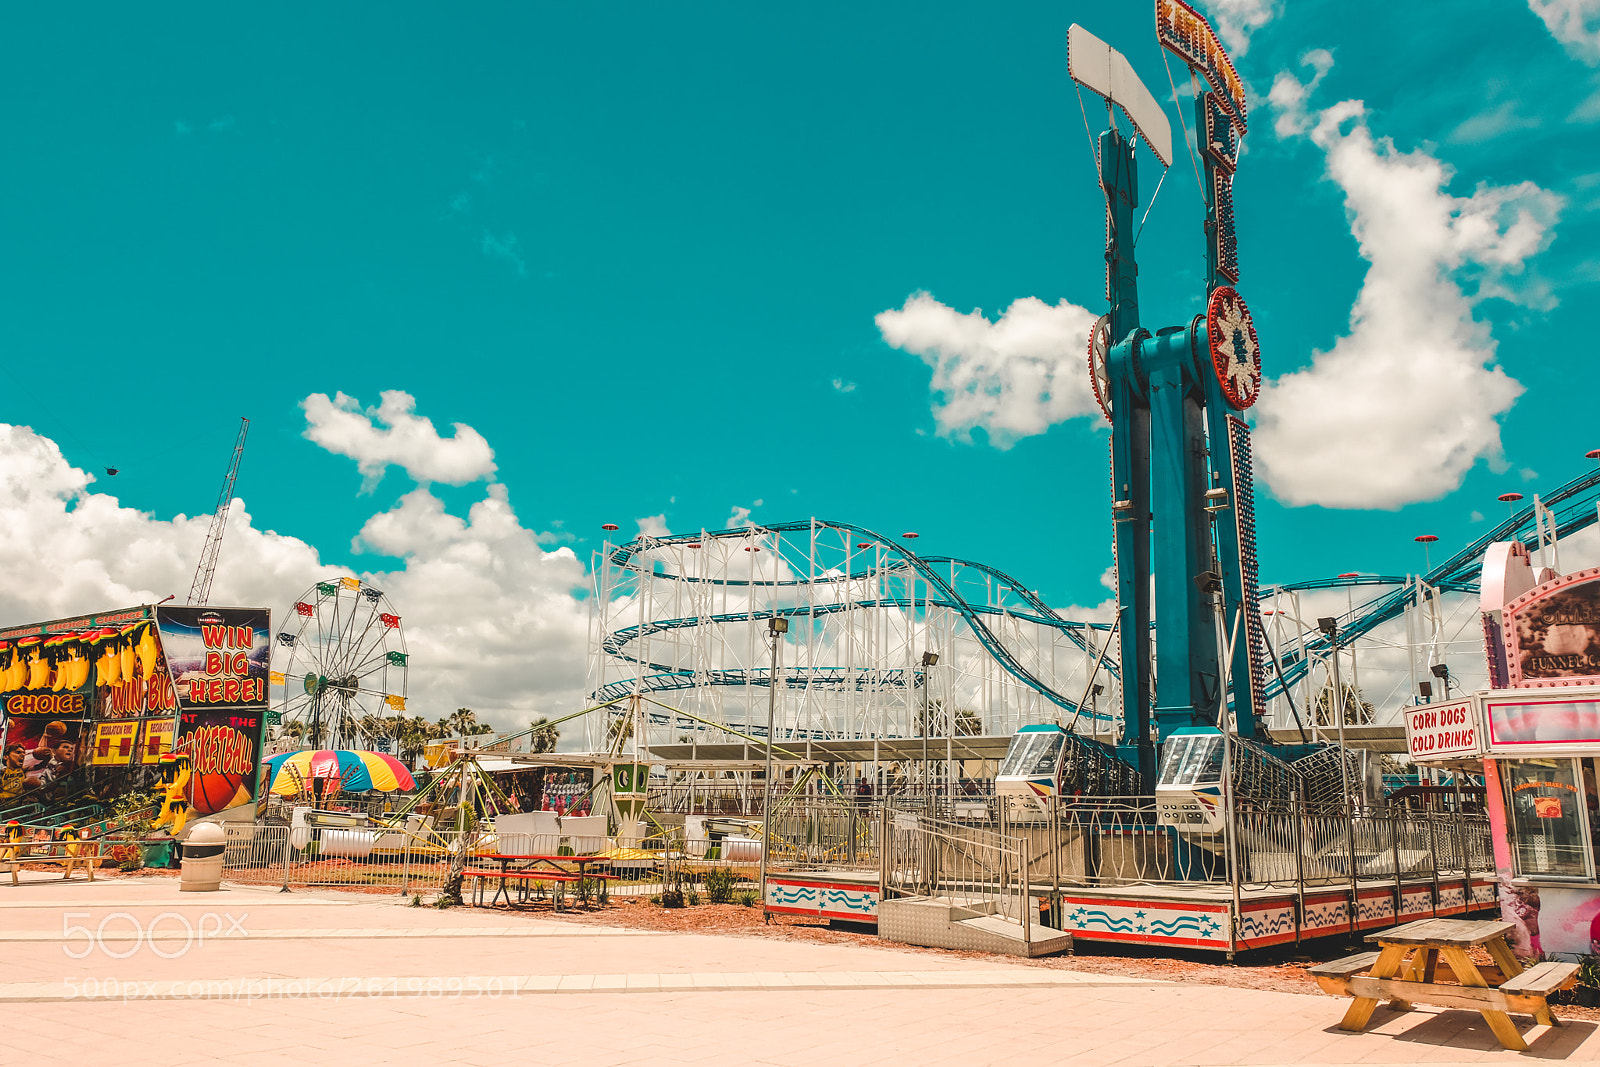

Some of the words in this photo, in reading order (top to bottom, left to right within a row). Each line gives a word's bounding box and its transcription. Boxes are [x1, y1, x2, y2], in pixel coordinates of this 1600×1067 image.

[1, 627, 42, 639] CHOICE
[46, 619, 91, 632] CHOICE
[95, 611, 144, 625] CHOICE
[202, 625, 253, 649] WIN
[206, 652, 249, 676] BIG
[1531, 655, 1583, 670] FUNNEL
[1588, 654, 1600, 667] C
[112, 675, 142, 714] WIN
[148, 672, 175, 711] BIG
[190, 678, 264, 703] HERE!
[7, 694, 84, 714] CHOICE
[181, 713, 198, 723] AT
[229, 717, 257, 727] THE
[1413, 712, 1437, 730] CORN
[1440, 707, 1466, 727] DOGS
[1413, 734, 1435, 752] COLD
[1438, 729, 1474, 749] DRINKS
[1512, 781, 1542, 792] LEMONADE
[1566, 784, 1578, 793] UPS
